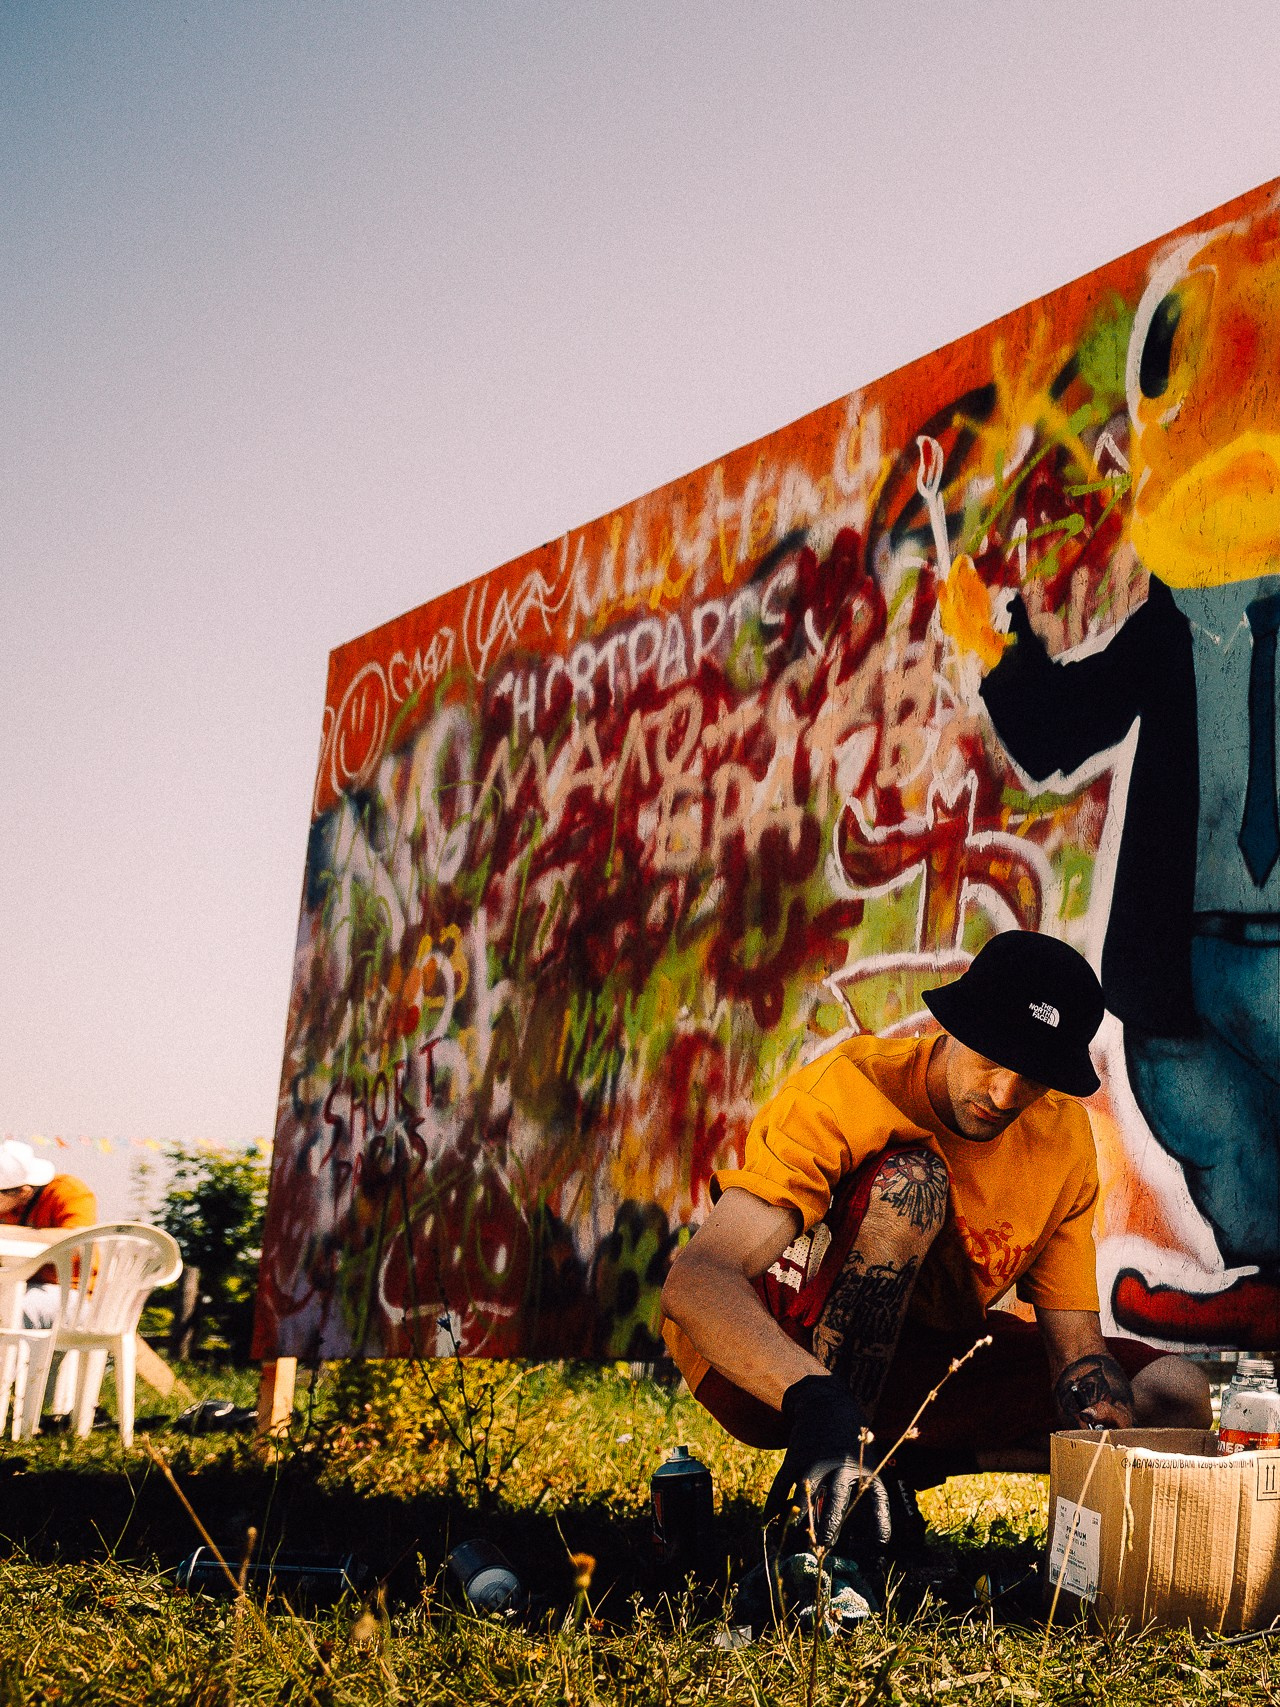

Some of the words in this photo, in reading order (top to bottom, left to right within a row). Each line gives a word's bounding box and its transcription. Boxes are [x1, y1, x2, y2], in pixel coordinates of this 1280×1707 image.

[1028, 1002, 1051, 1017] NORTH
[1041, 1001, 1053, 1012] THE
[1032, 1010, 1048, 1023] FACE
